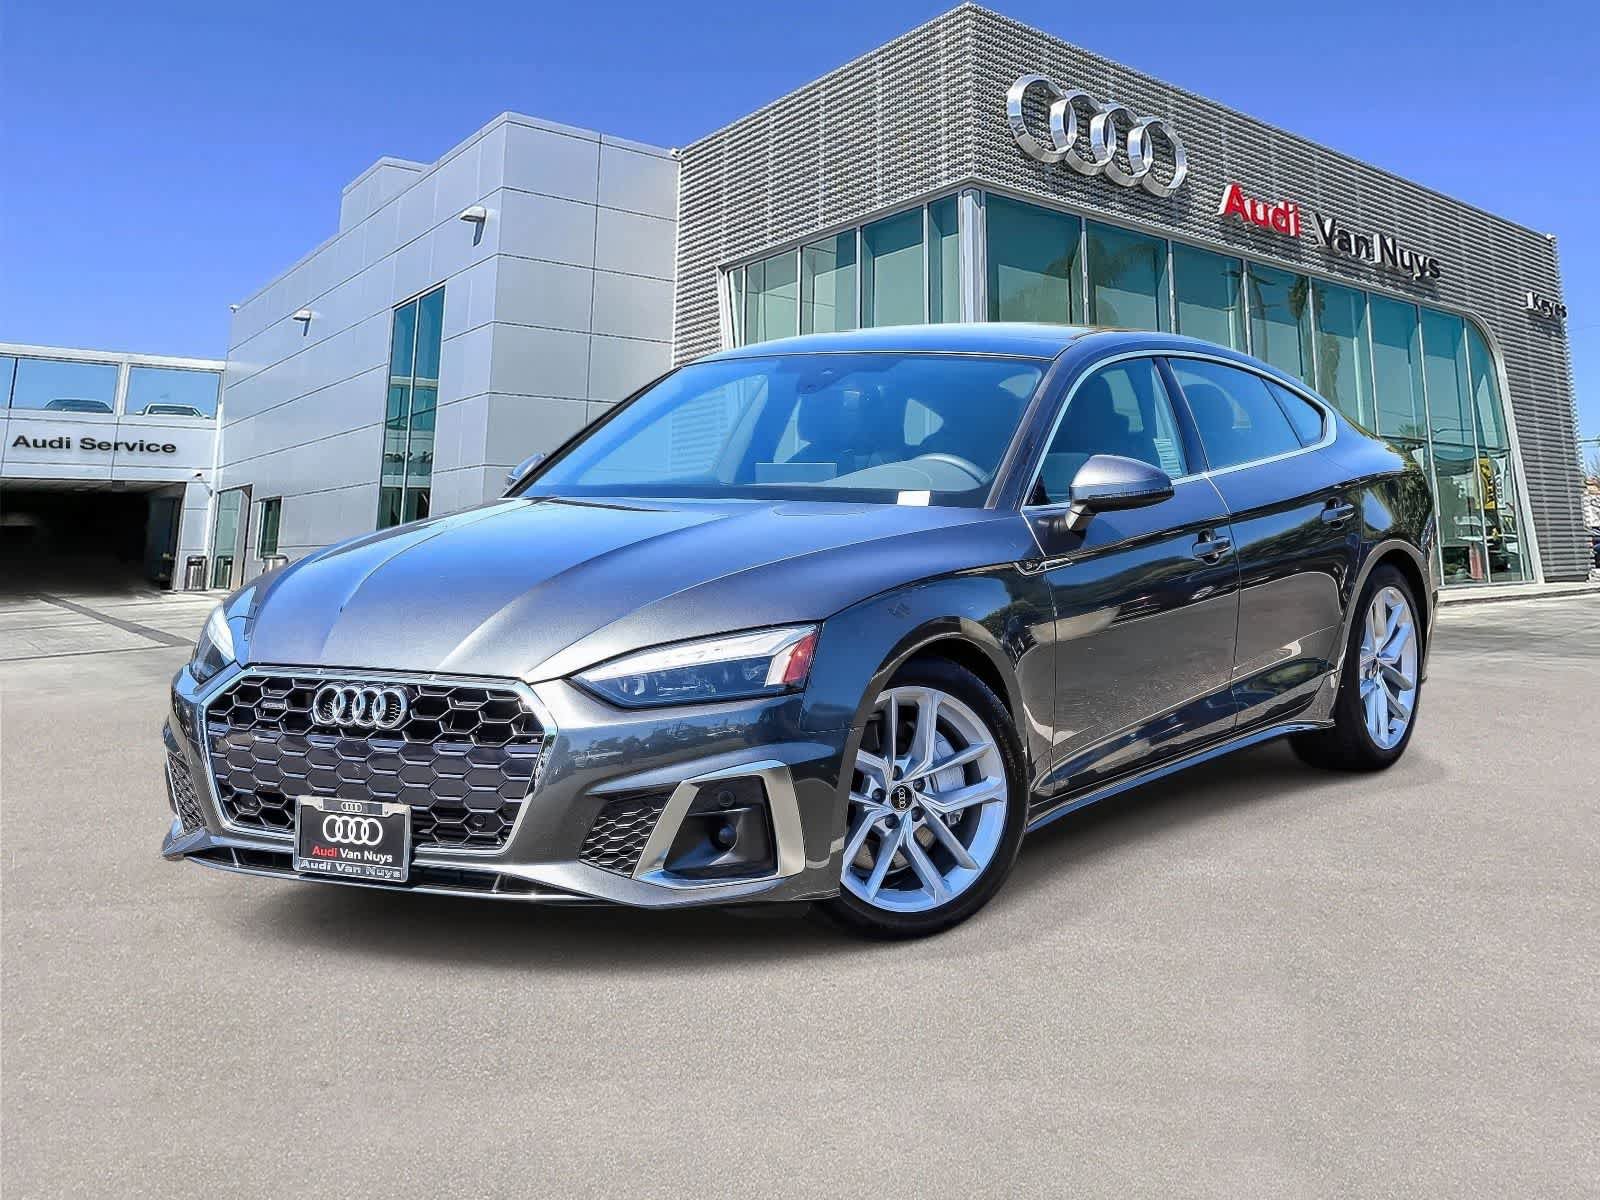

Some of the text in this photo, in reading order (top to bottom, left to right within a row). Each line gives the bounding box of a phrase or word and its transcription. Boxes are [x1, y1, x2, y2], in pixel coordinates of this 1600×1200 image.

[1218, 182, 1442, 281] Audi Van Nuys
[12, 435, 177, 453] Audi Service
[312, 845, 393, 864] Audi Van Nuys
[300, 860, 401, 879] Audi Van Nuys
